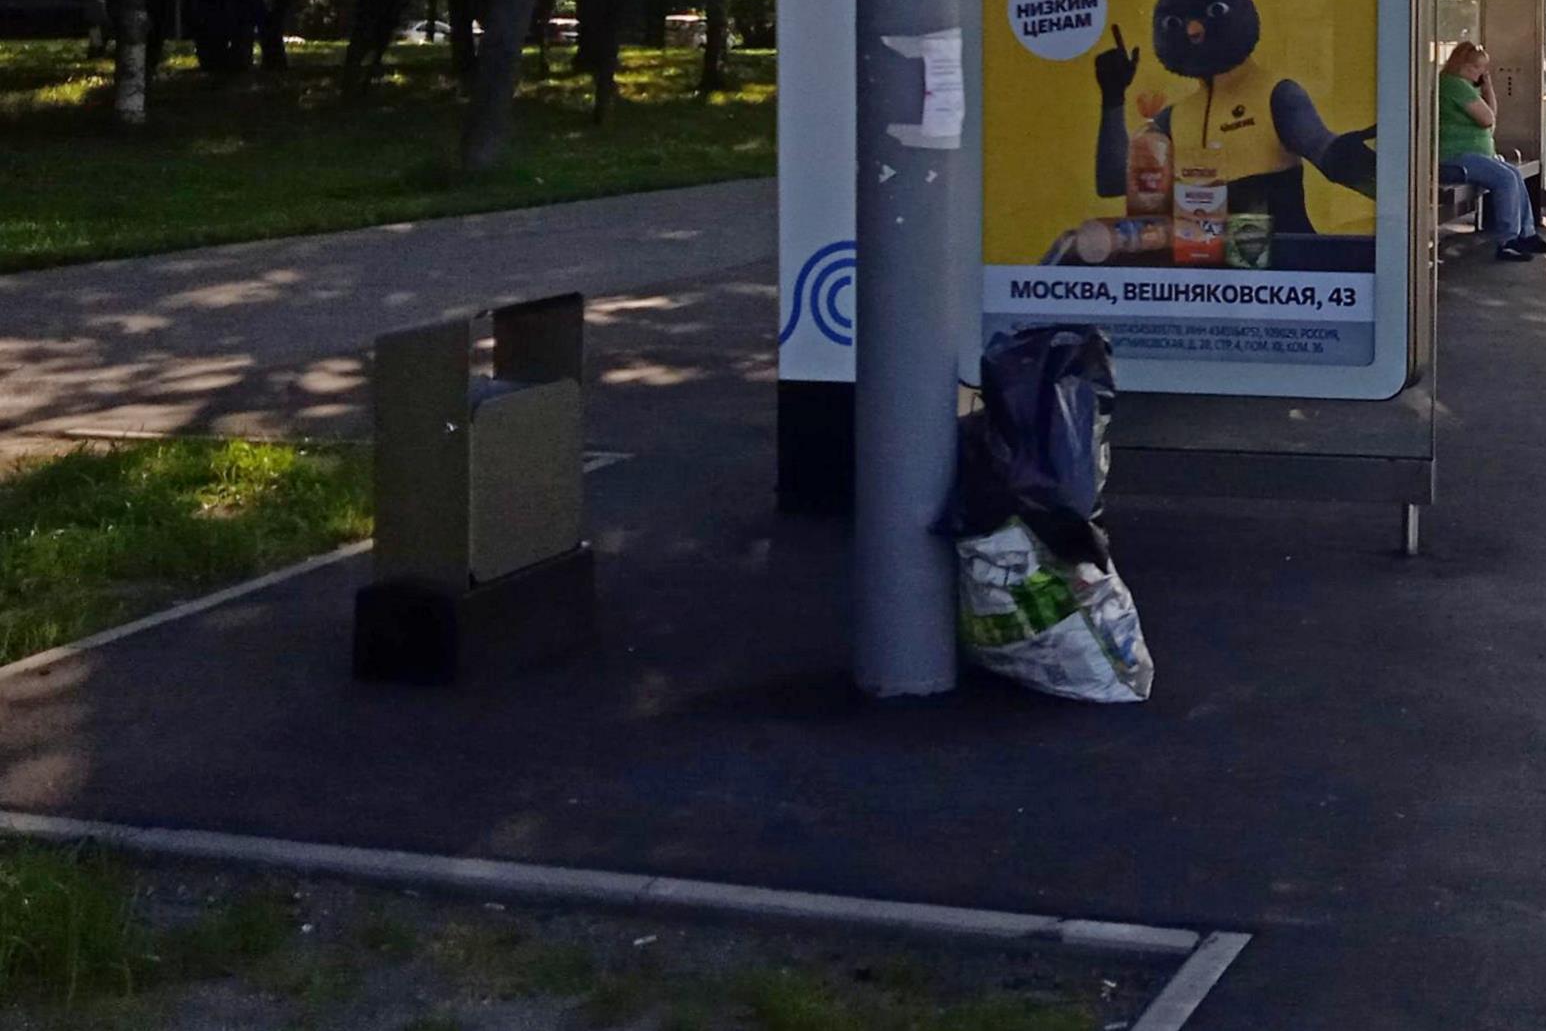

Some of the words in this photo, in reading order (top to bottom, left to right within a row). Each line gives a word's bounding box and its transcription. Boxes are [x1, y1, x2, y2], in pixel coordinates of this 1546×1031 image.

[1023, 13, 1093, 38] ЦЕНАМ
[1010, 279, 1118, 305] МОСКВА,
[1123, 281, 1324, 310] ВЕШНЯКОВСКАЯ,
[1328, 288, 1356, 306] 43
